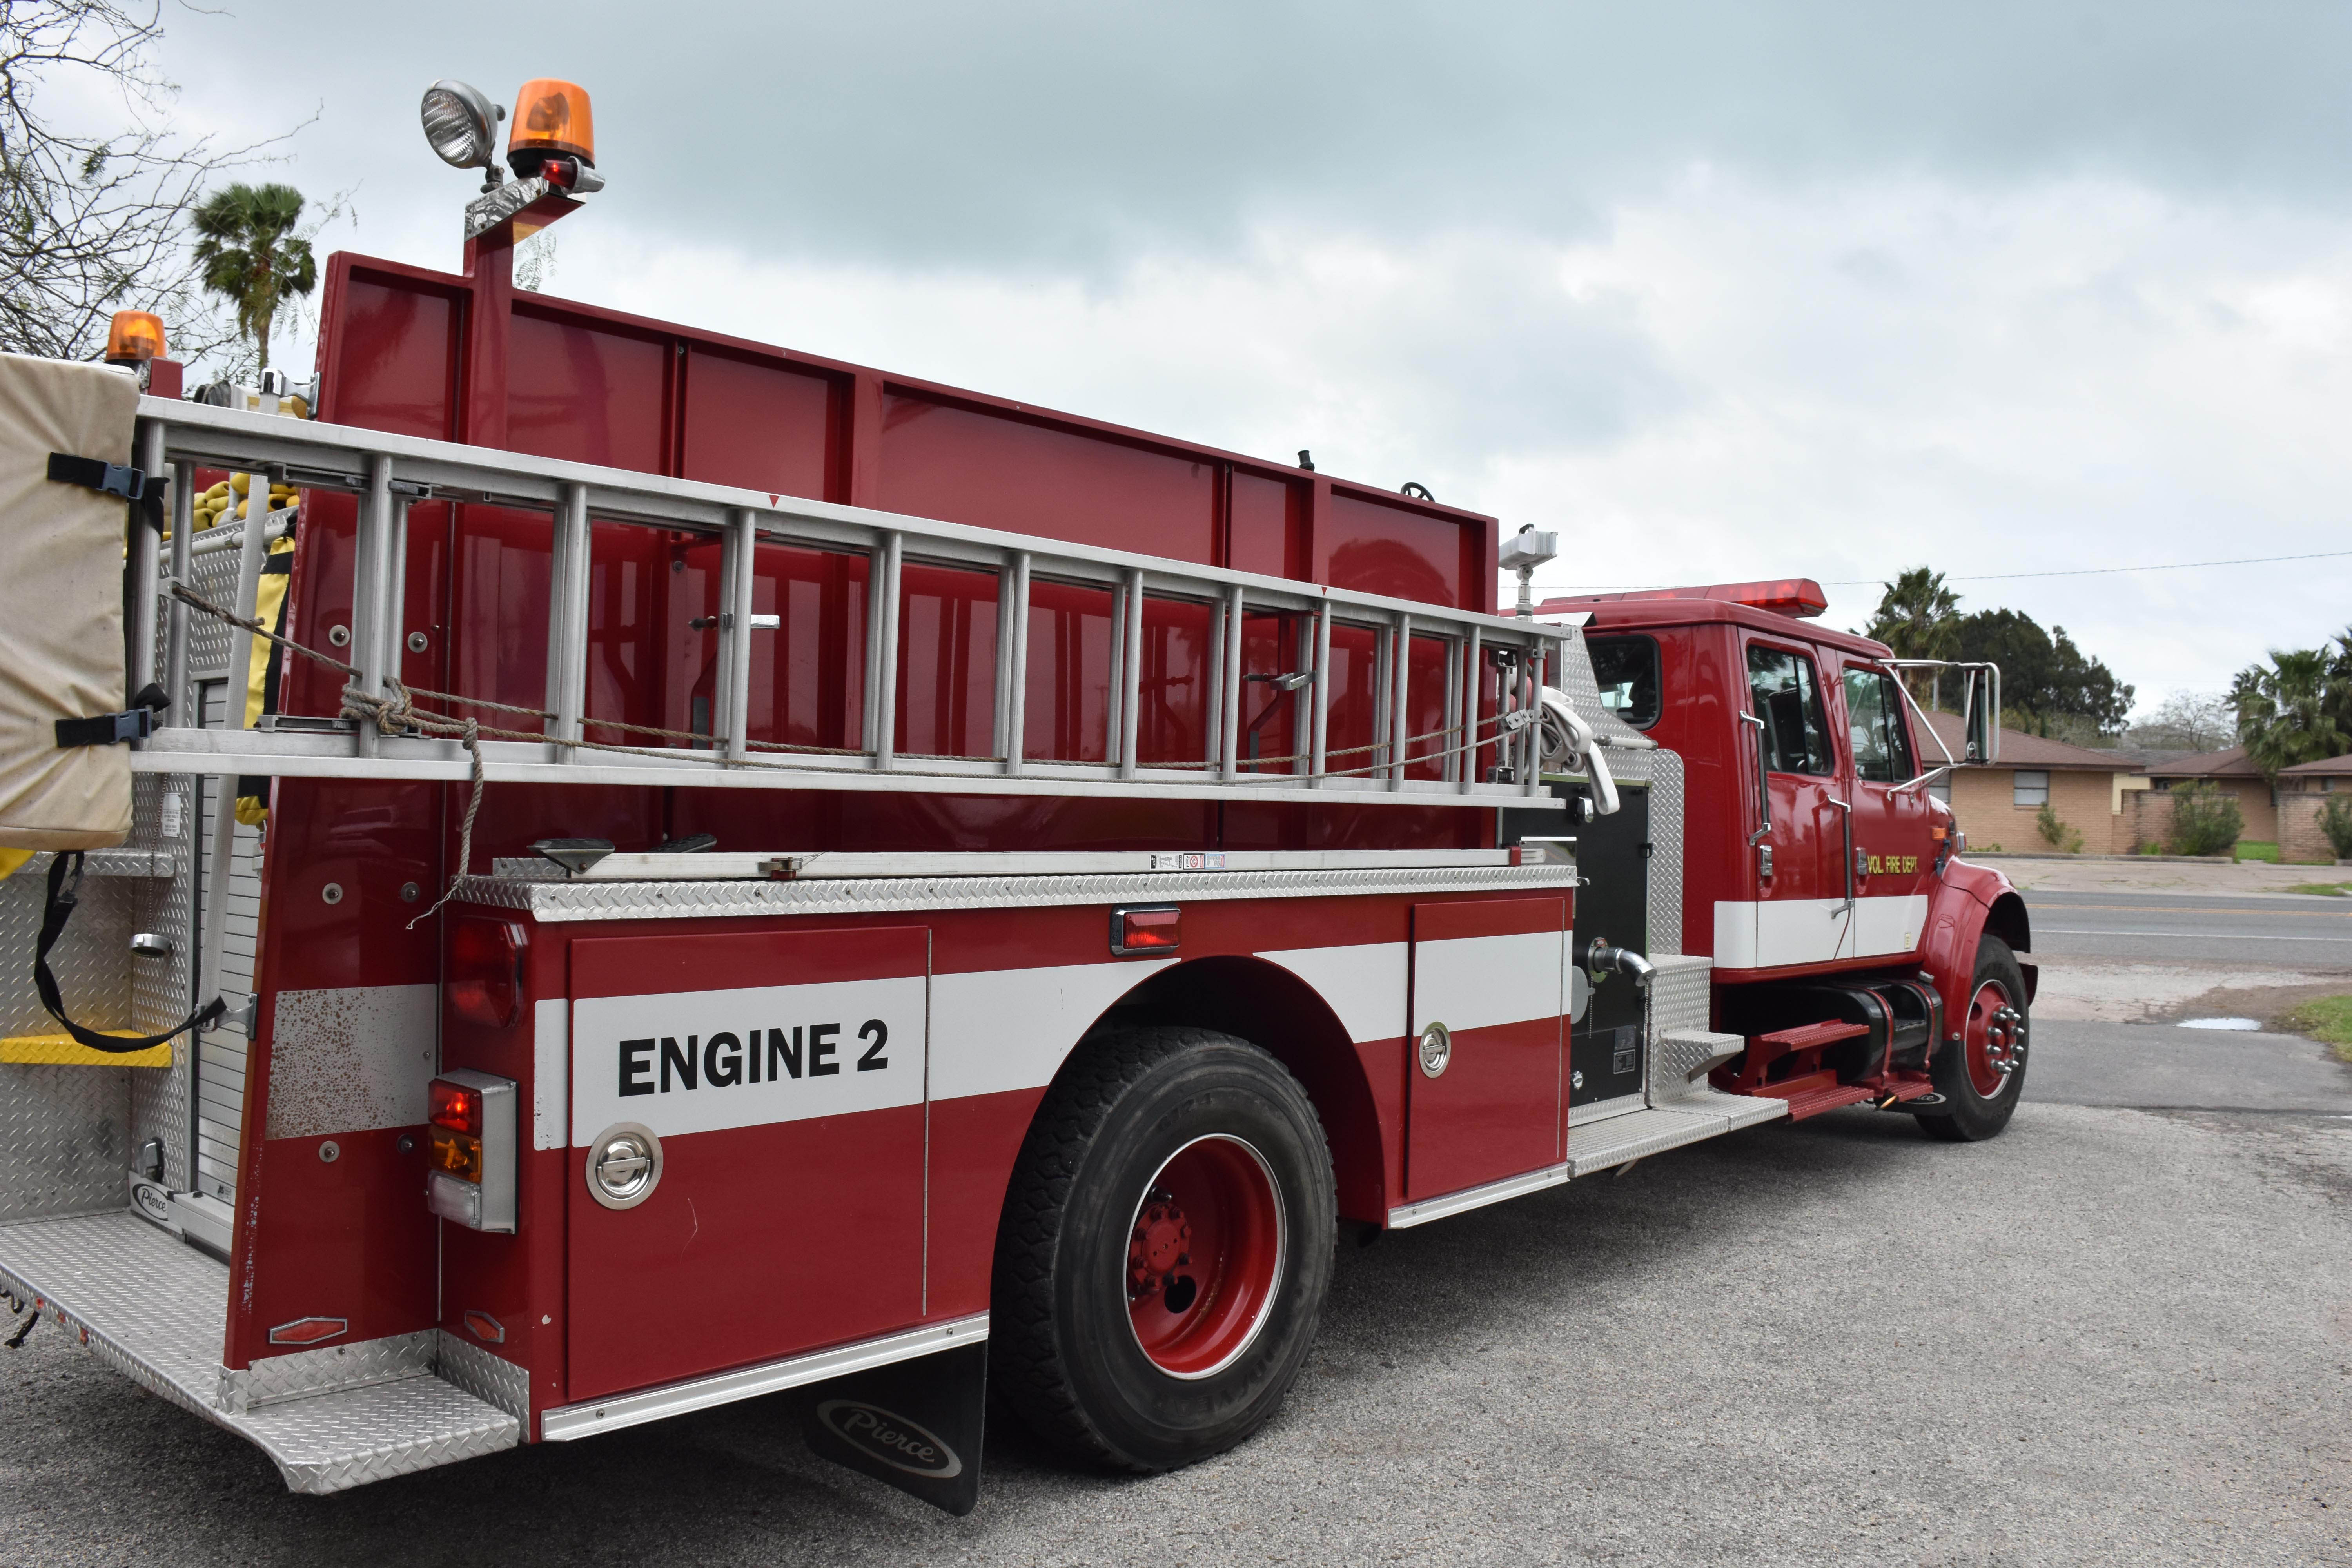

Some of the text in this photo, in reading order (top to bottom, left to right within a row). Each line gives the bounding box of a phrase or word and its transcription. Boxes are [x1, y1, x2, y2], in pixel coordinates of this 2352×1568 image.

[1886, 855, 1901, 873] FIRE
[1902, 856, 1919, 873] DEPT.
[619, 1019, 888, 1097] ENGINE 2
[141, 1188, 166, 1212] Pierce
[844, 1408, 935, 1463] Pierce
